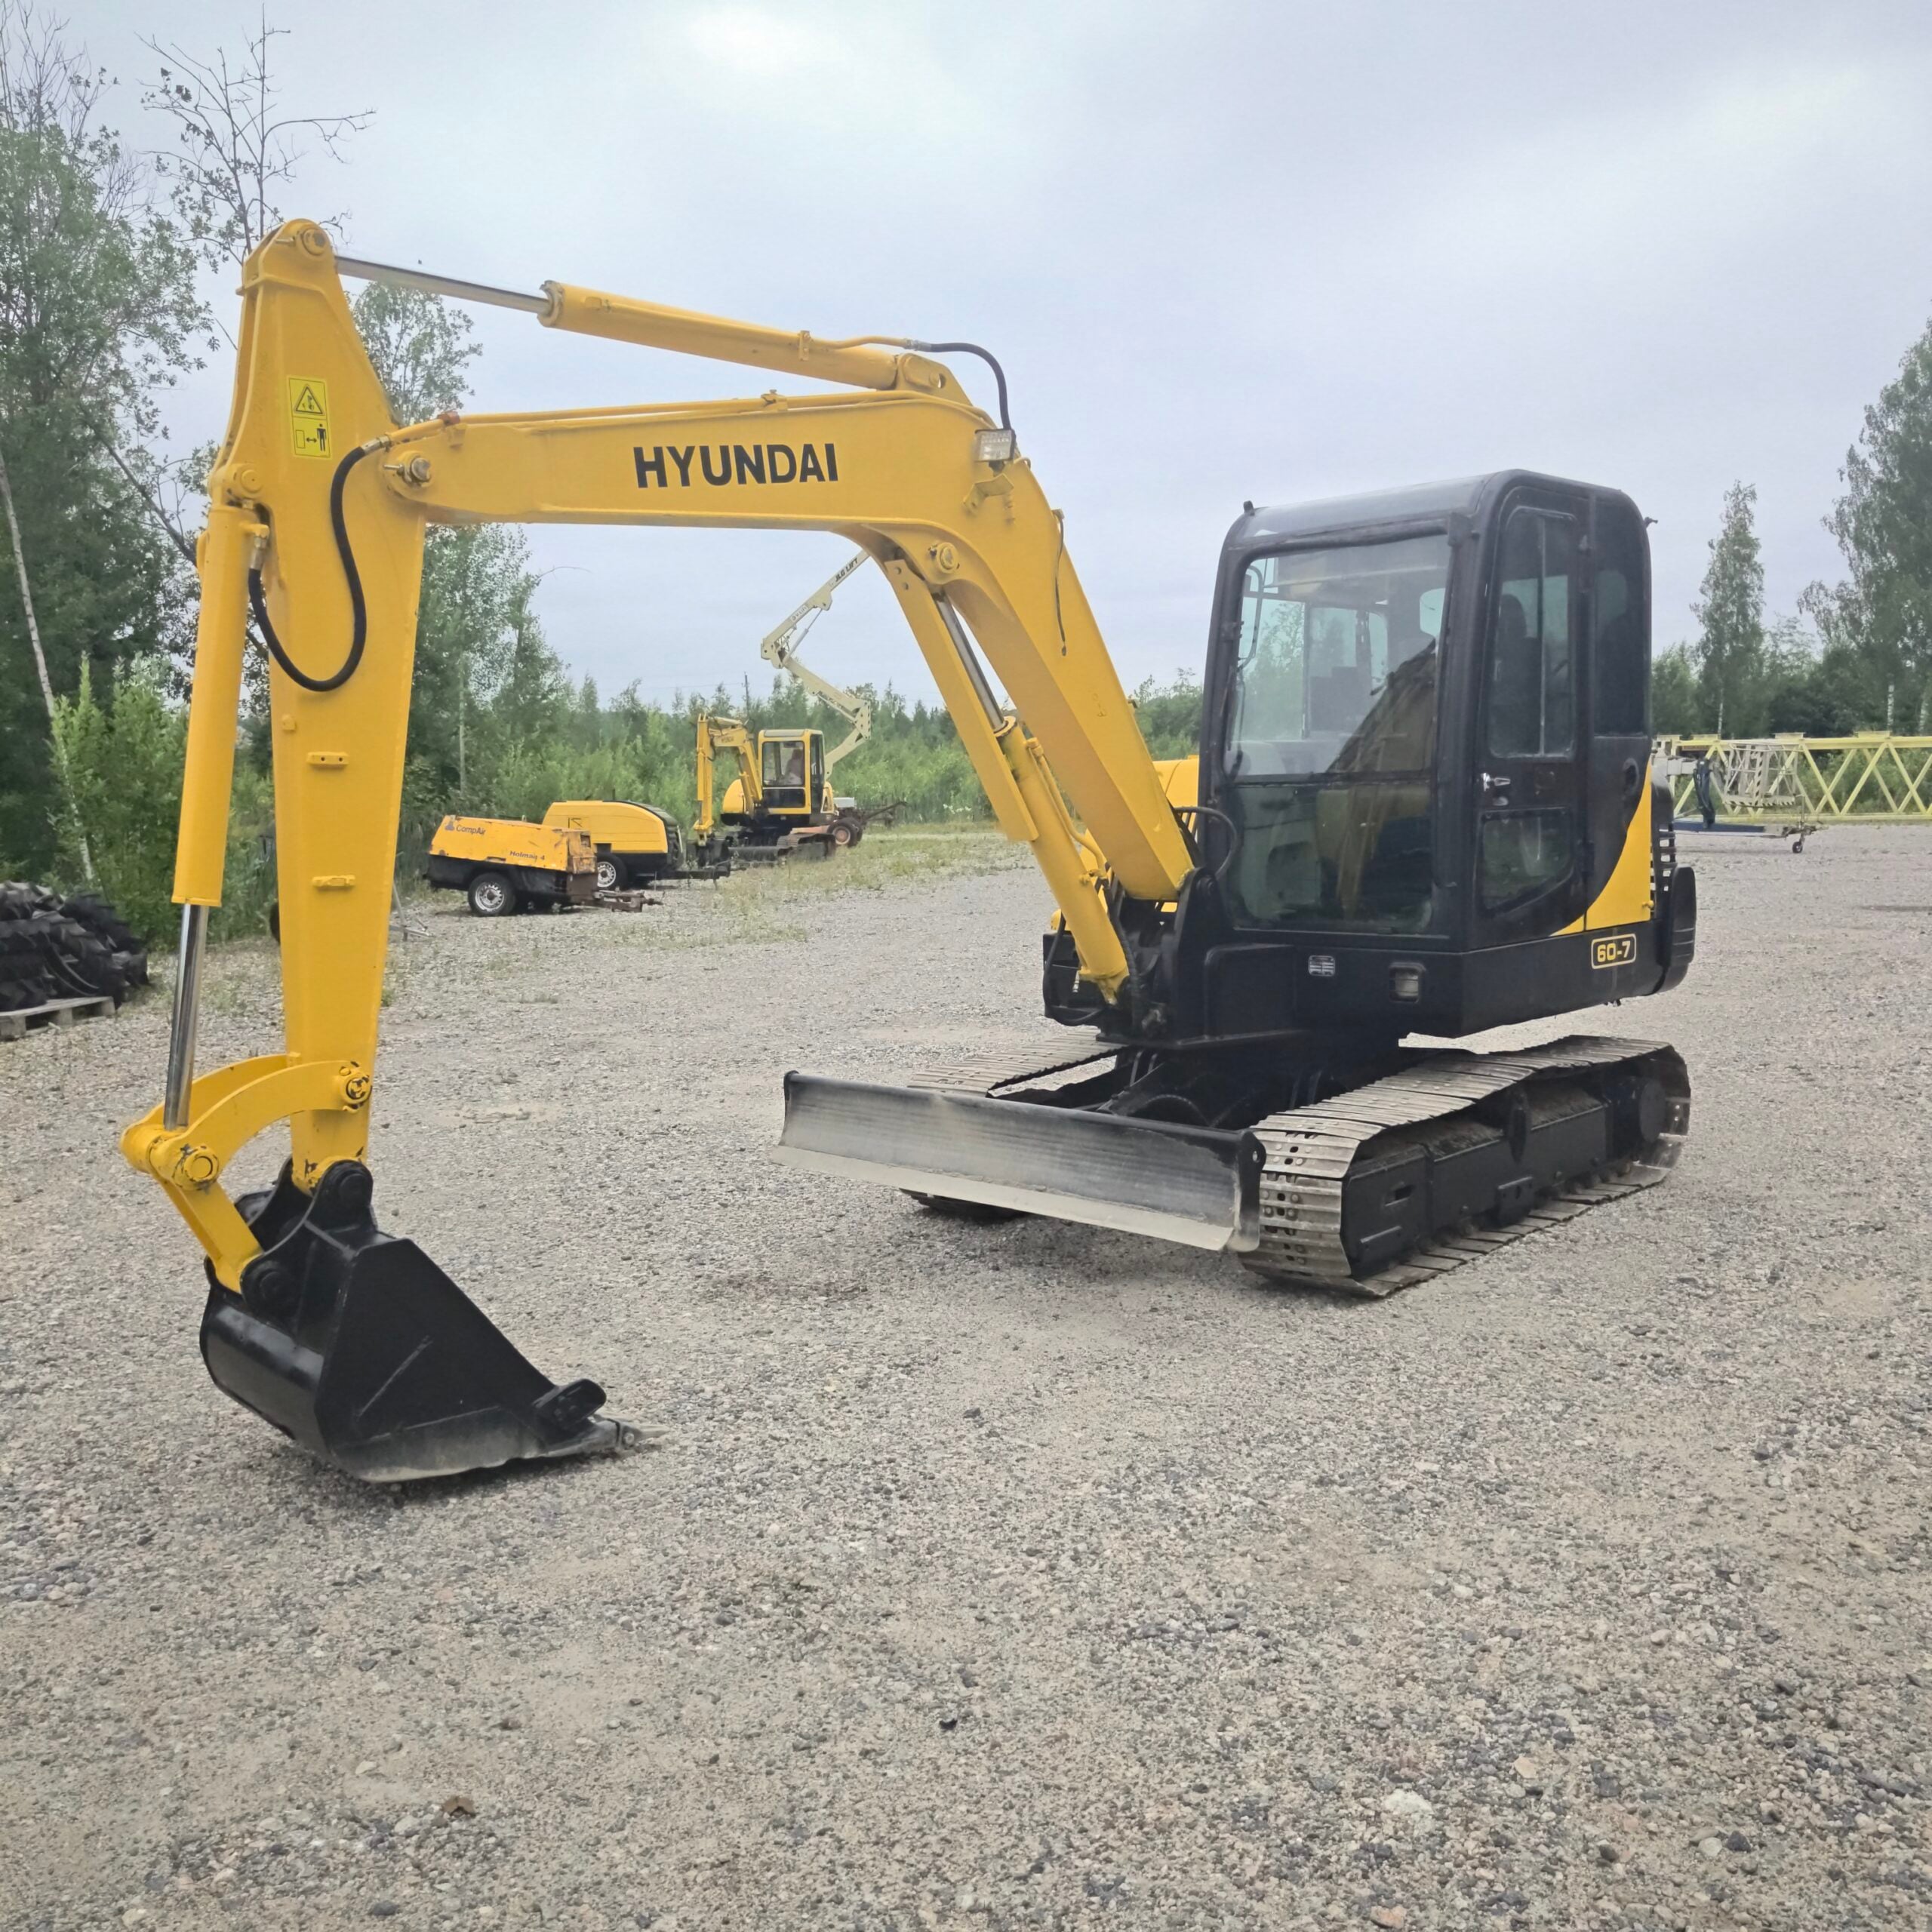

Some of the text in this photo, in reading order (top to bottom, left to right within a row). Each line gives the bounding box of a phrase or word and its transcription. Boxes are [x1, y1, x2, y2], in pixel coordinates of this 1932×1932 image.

[633, 443, 838, 488] HYUNDAI
[456, 824, 486, 835] CompAir
[1597, 940, 1631, 962] 60-7
